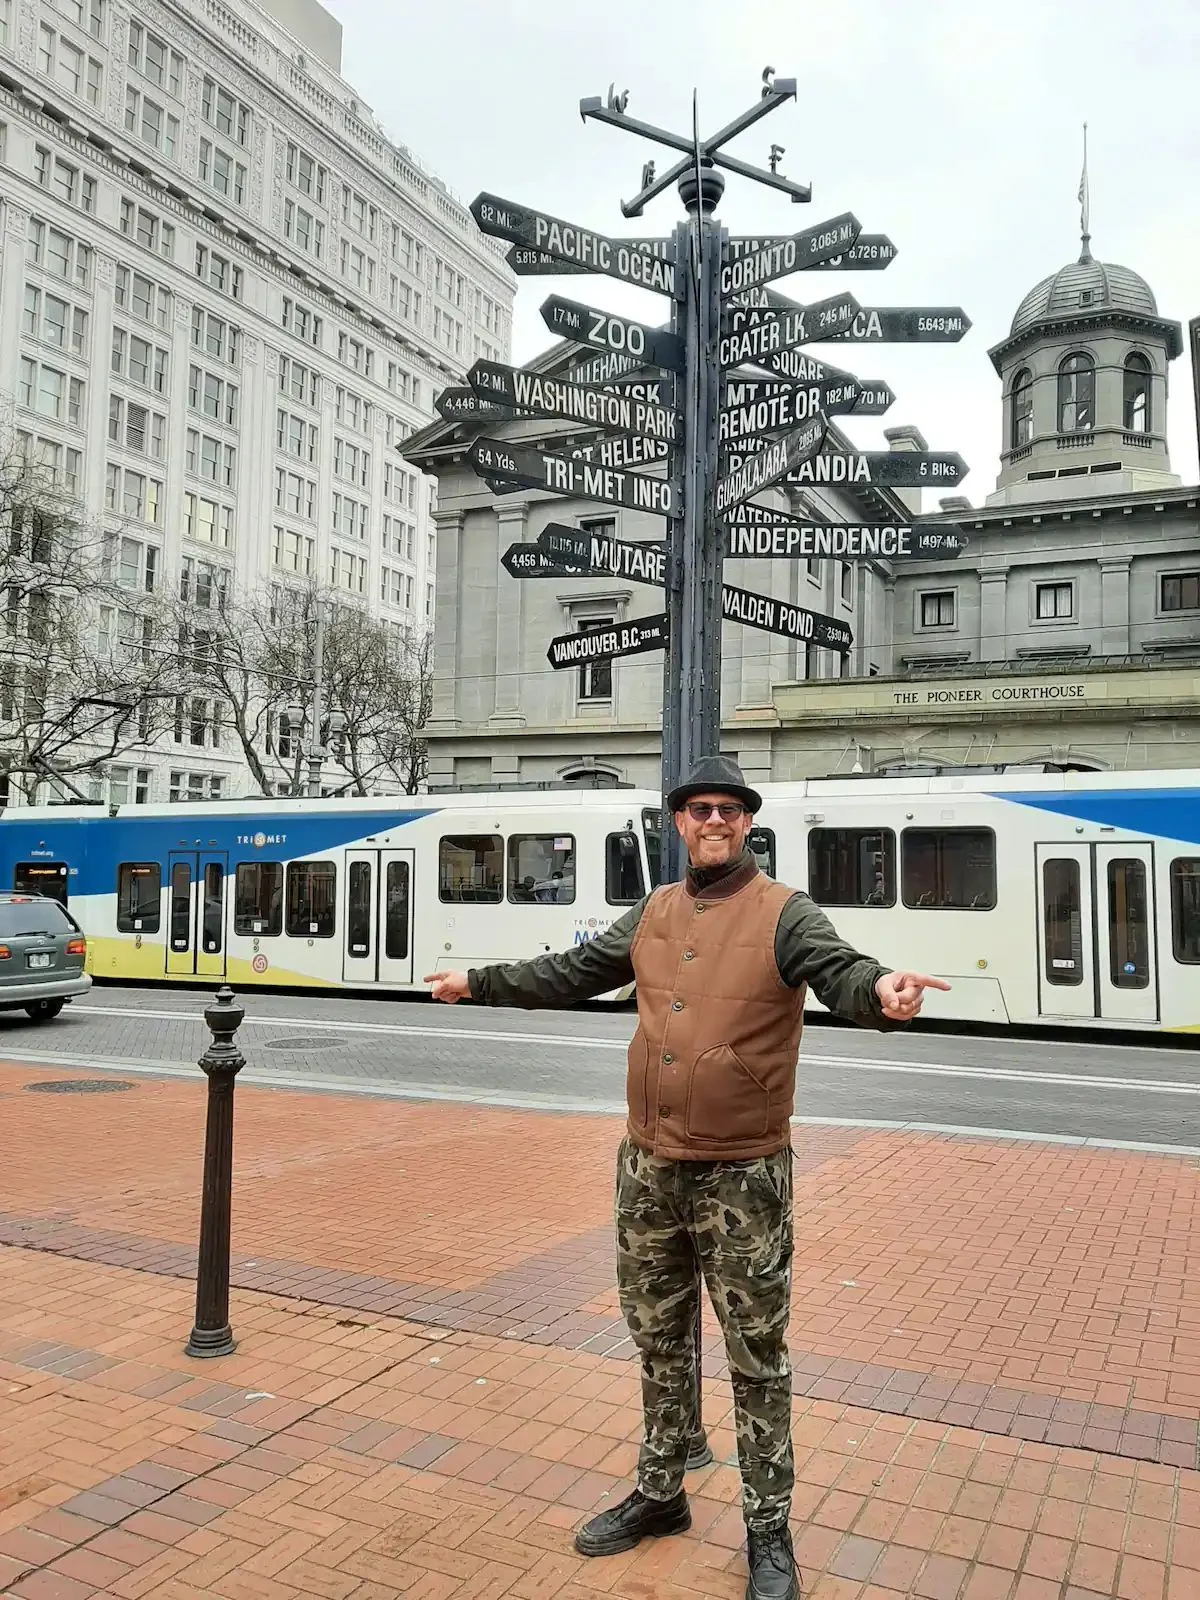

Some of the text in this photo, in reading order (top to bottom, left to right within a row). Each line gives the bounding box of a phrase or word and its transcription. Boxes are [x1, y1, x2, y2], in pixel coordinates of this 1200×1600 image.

[480, 203, 514, 229] 82 Mi.
[810, 229, 838, 253] 3,063
[839, 222, 855, 241] Mi.
[535, 216, 675, 293] PACIFIC OCEAN
[540, 253, 555, 264] Mi.
[720, 240, 797, 294] CORINTO
[819, 309, 838, 327] 245
[838, 303, 853, 321] Mi.
[588, 311, 645, 355] ZOO
[720, 321, 780, 366] CRATER
[784, 311, 810, 346] LK.
[772, 350, 824, 380] SQUARE
[492, 375, 508, 393] Mi.
[727, 384, 759, 408] MT
[825, 387, 842, 406] 182
[843, 384, 858, 401] Mi.
[445, 397, 475, 410] 4,446
[512, 371, 631, 429] WASHINGTON
[635, 406, 677, 441] PARK
[860, 391, 874, 405] 70
[719, 387, 821, 442] REMOTE, OR
[477, 448, 518, 472] 54 Yds.
[602, 437, 669, 467] HELENS
[716, 439, 788, 511] GUADALAJARA
[919, 461, 959, 476] 5 Blks.
[542, 456, 672, 511] TRI-MET INFO
[730, 527, 912, 555] INDEPENDENCE
[511, 553, 536, 568] 4,456
[590, 537, 667, 583] MUTARE
[721, 588, 814, 639] WALDEN POND
[621, 627, 641, 649] B.C.
[640, 630, 651, 640] 313
[893, 685, 1085, 704] THE PIONEER COURTHOUSE
